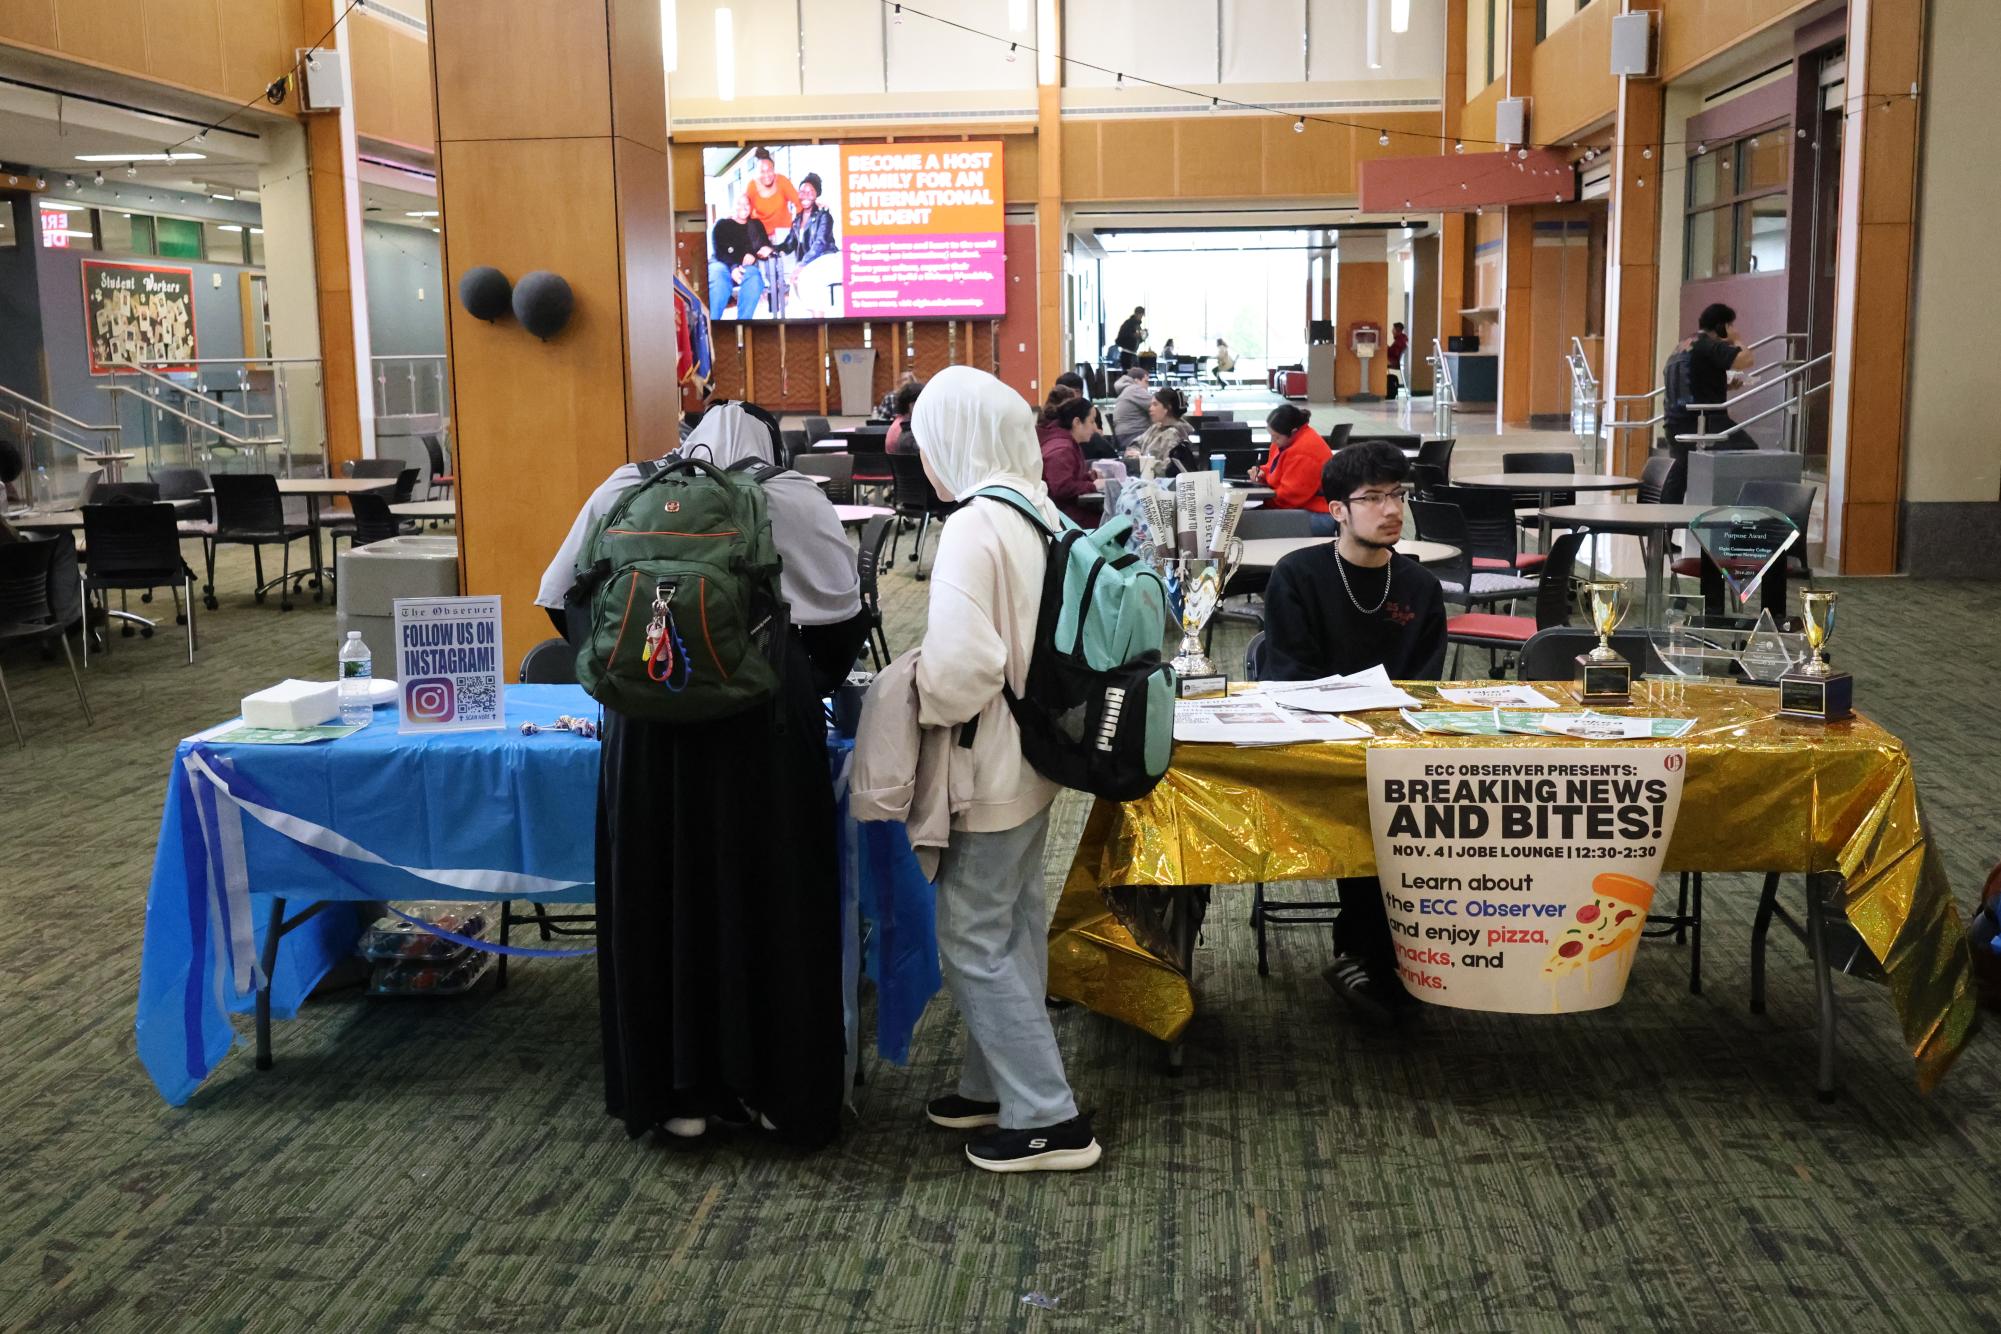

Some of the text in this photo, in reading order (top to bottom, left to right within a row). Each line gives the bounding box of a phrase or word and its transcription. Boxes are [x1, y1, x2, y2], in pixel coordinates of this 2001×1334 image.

[848, 152, 992, 171] BECOME A HOST
[849, 171, 984, 190] FAMILY FOR AN
[849, 189, 994, 208] INTERNATIONAL
[849, 208, 932, 226] STUDENT
[101, 272, 179, 292] Student Workers
[1187, 492, 1197, 522] PATHWAY
[402, 606, 494, 618] The Observer
[403, 621, 494, 648] FOLLOW US ON
[405, 647, 495, 676] INSTAGRAM!
[1425, 764, 1637, 776] ECC OBSERVER PRESENTS:
[1385, 779, 1668, 803] BREAKING NEWS
[1387, 804, 1664, 840] AND BITES!
[1393, 845, 1656, 859] NOV. 4 JOBE LOUNGE 12:30-2:30
[1402, 873, 1533, 891] Learn about
[1386, 891, 1567, 918] the ECC Observer
[1390, 918, 1549, 947] and enjoy pizza,
[1392, 940, 1504, 968] nacks, and
[1397, 960, 1446, 990] rinks.
